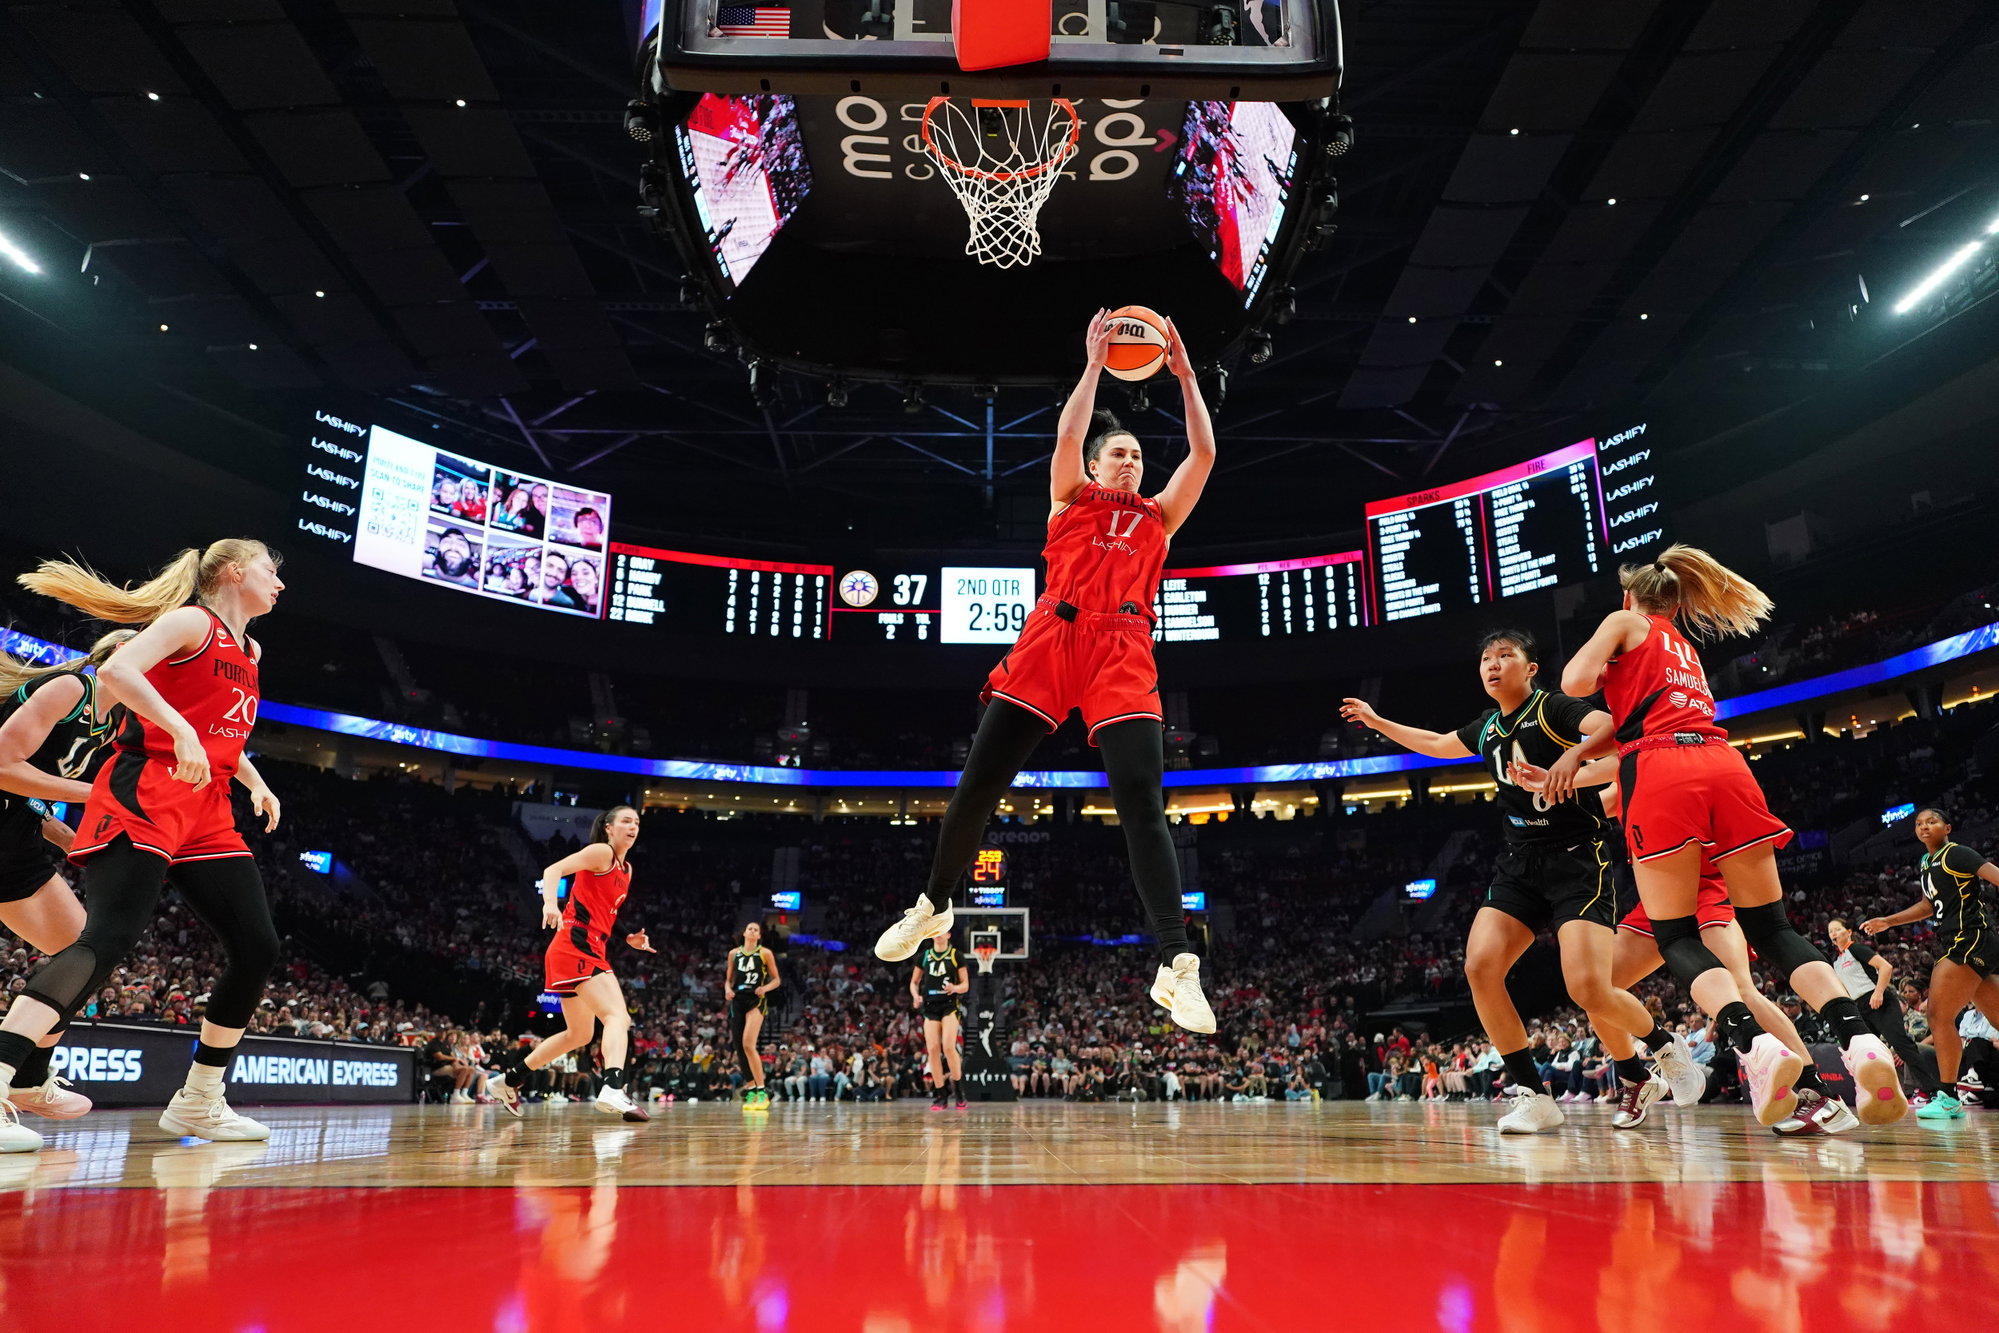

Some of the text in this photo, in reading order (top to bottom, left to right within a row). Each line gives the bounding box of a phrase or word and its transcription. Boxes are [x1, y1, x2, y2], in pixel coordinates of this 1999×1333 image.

[315, 409, 367, 437] LASHIFY
[311, 436, 363, 464] LASHIFY
[1599, 423, 1647, 451] LASHIFY
[1527, 459, 1546, 474] FIRE
[1603, 449, 1651, 476] LASHIFY
[307, 463, 360, 490] LASHIFY
[1606, 475, 1655, 502] LASHIFY
[302, 490, 355, 516] LASHIFY
[1406, 490, 1440, 507] SPARKS
[1106, 510, 1144, 538] 17
[1610, 501, 1659, 528] LASHIFY
[298, 518, 352, 544] LASHIFY
[1613, 528, 1663, 554] LASHIFY
[1092, 536, 1138, 556] LASHIFY
[618, 555, 625, 566] 2
[729, 569, 738, 581] 3
[774, 573, 782, 584] 3
[1163, 579, 1187, 591] LEITE
[1258, 573, 1270, 586] 12
[1283, 571, 1289, 583] 1
[1348, 563, 1353, 575] 1
[729, 582, 737, 593] 7
[751, 584, 759, 595] 4
[773, 586, 781, 597] 2
[795, 587, 803, 599] 2
[817, 589, 822, 600] 1
[892, 574, 928, 605] 37
[957, 578, 1020, 596] 2ND QTR
[1260, 586, 1268, 598] 7
[1305, 581, 1311, 593] 1
[1348, 576, 1354, 587] 1
[1261, 598, 1268, 610] 3
[1348, 588, 1356, 600] 2
[613, 594, 624, 606] 12
[750, 610, 757, 621] 2
[772, 611, 780, 623] 2
[816, 614, 821, 625] 1
[728, 595, 736, 607] 4
[752, 597, 757, 609] 1
[774, 599, 780, 610] 1
[816, 601, 822, 612] 1
[1261, 611, 1269, 623] 2
[1284, 609, 1291, 621] 2
[1349, 601, 1355, 613] 1
[610, 607, 623, 620] 22
[750, 623, 756, 635] 1
[813, 626, 821, 638] 2
[878, 613, 904, 624] FOULS
[969, 603, 1025, 631] 2:59
[1286, 622, 1291, 634] 1
[1307, 619, 1314, 632] 2
[886, 625, 928, 640] 2 5
[1660, 630, 1707, 682] 44
[213, 658, 259, 693] PORTLA
[1665, 667, 1713, 700] SAMUELS
[222, 687, 258, 726] 20
[208, 723, 250, 740] LASH
[1520, 720, 1538, 729] Albert
[1492, 739, 1532, 786] LA
[30, 799, 46, 813] UCLA
[1525, 818, 1549, 826] Health
[988, 831, 1050, 844] oregon
[978, 850, 1003, 862] 2:59
[974, 861, 1000, 881] 24
[1934, 899, 1944, 919] 2
[738, 957, 755, 972] LA
[929, 961, 946, 977] LA
[745, 972, 759, 985] 12
[51, 1046, 143, 1082] PRESS
[231, 1055, 399, 1086] AMERICAN EXPRESS
